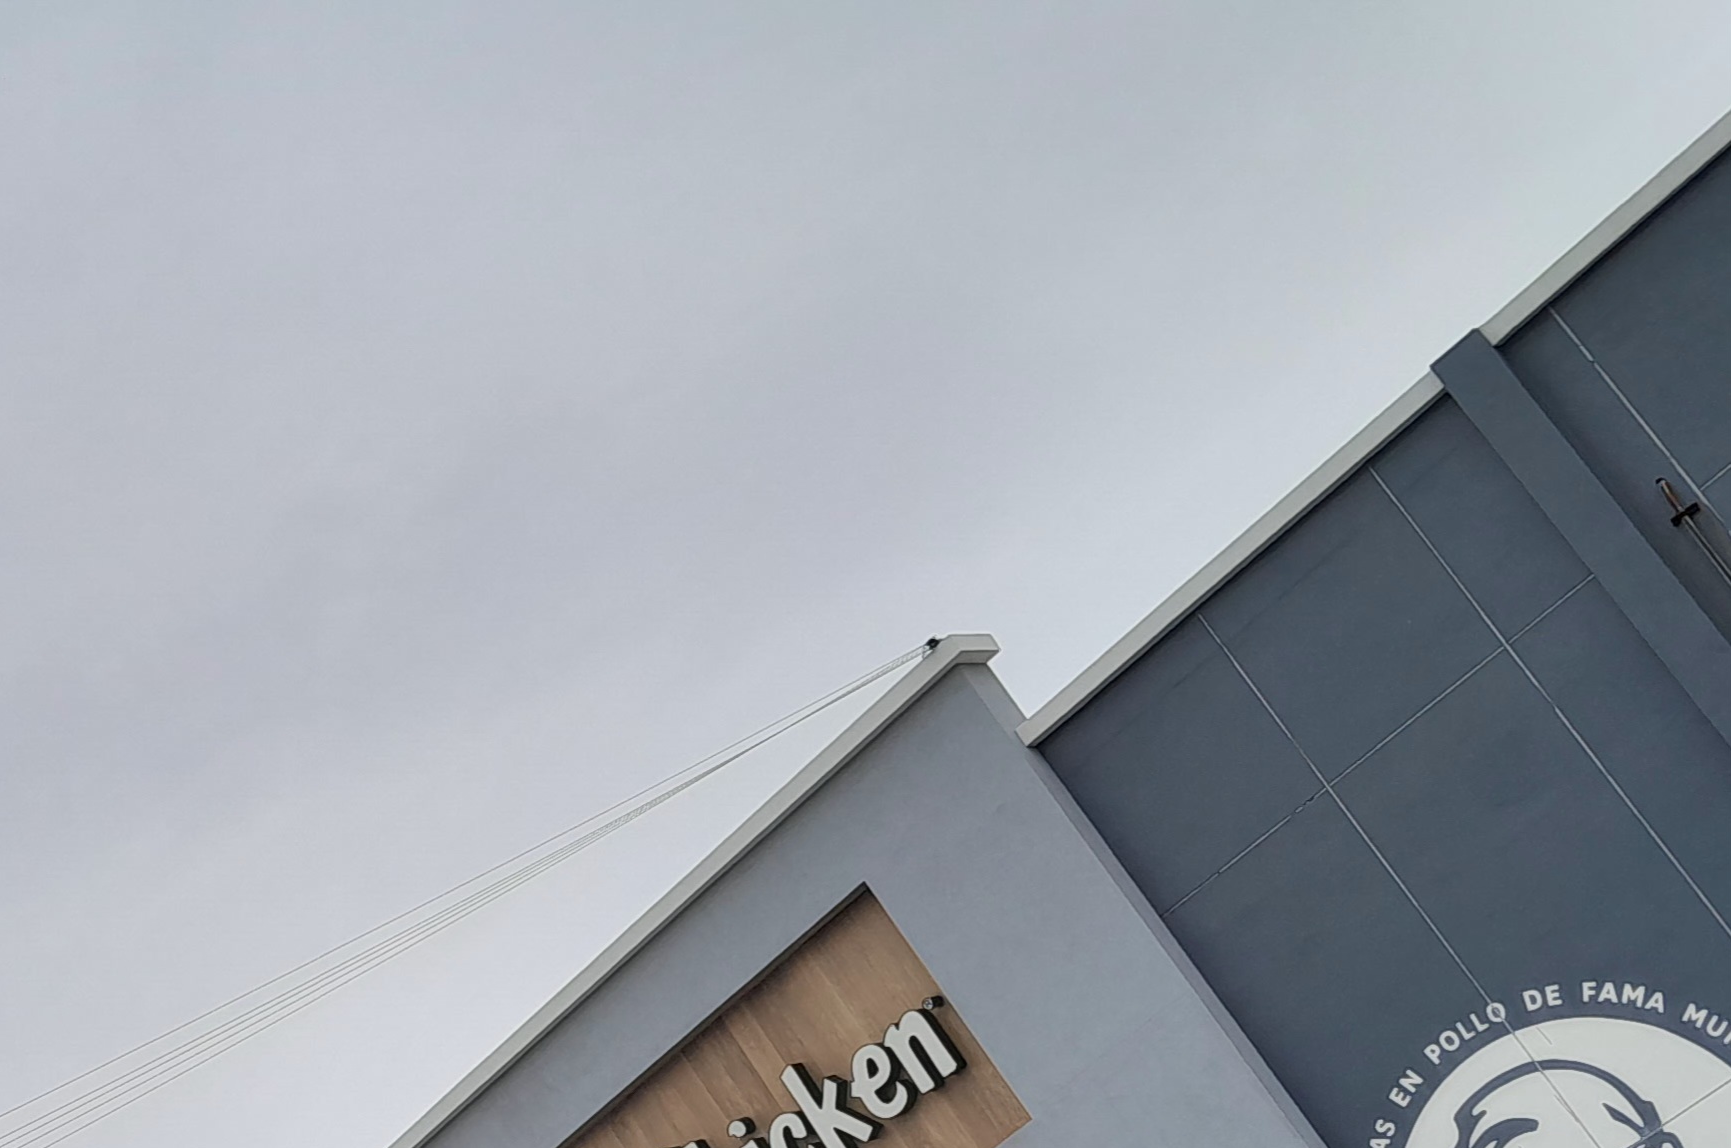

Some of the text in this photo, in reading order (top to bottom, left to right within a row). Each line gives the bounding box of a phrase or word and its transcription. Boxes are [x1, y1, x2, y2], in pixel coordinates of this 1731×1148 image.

[1389, 1069, 1424, 1108] EN
[1424, 1002, 1506, 1065] POLLO
[1522, 983, 1563, 1011] DE
[1581, 981, 1665, 1013] FAMA
[1682, 1003, 1731, 1045] MU
